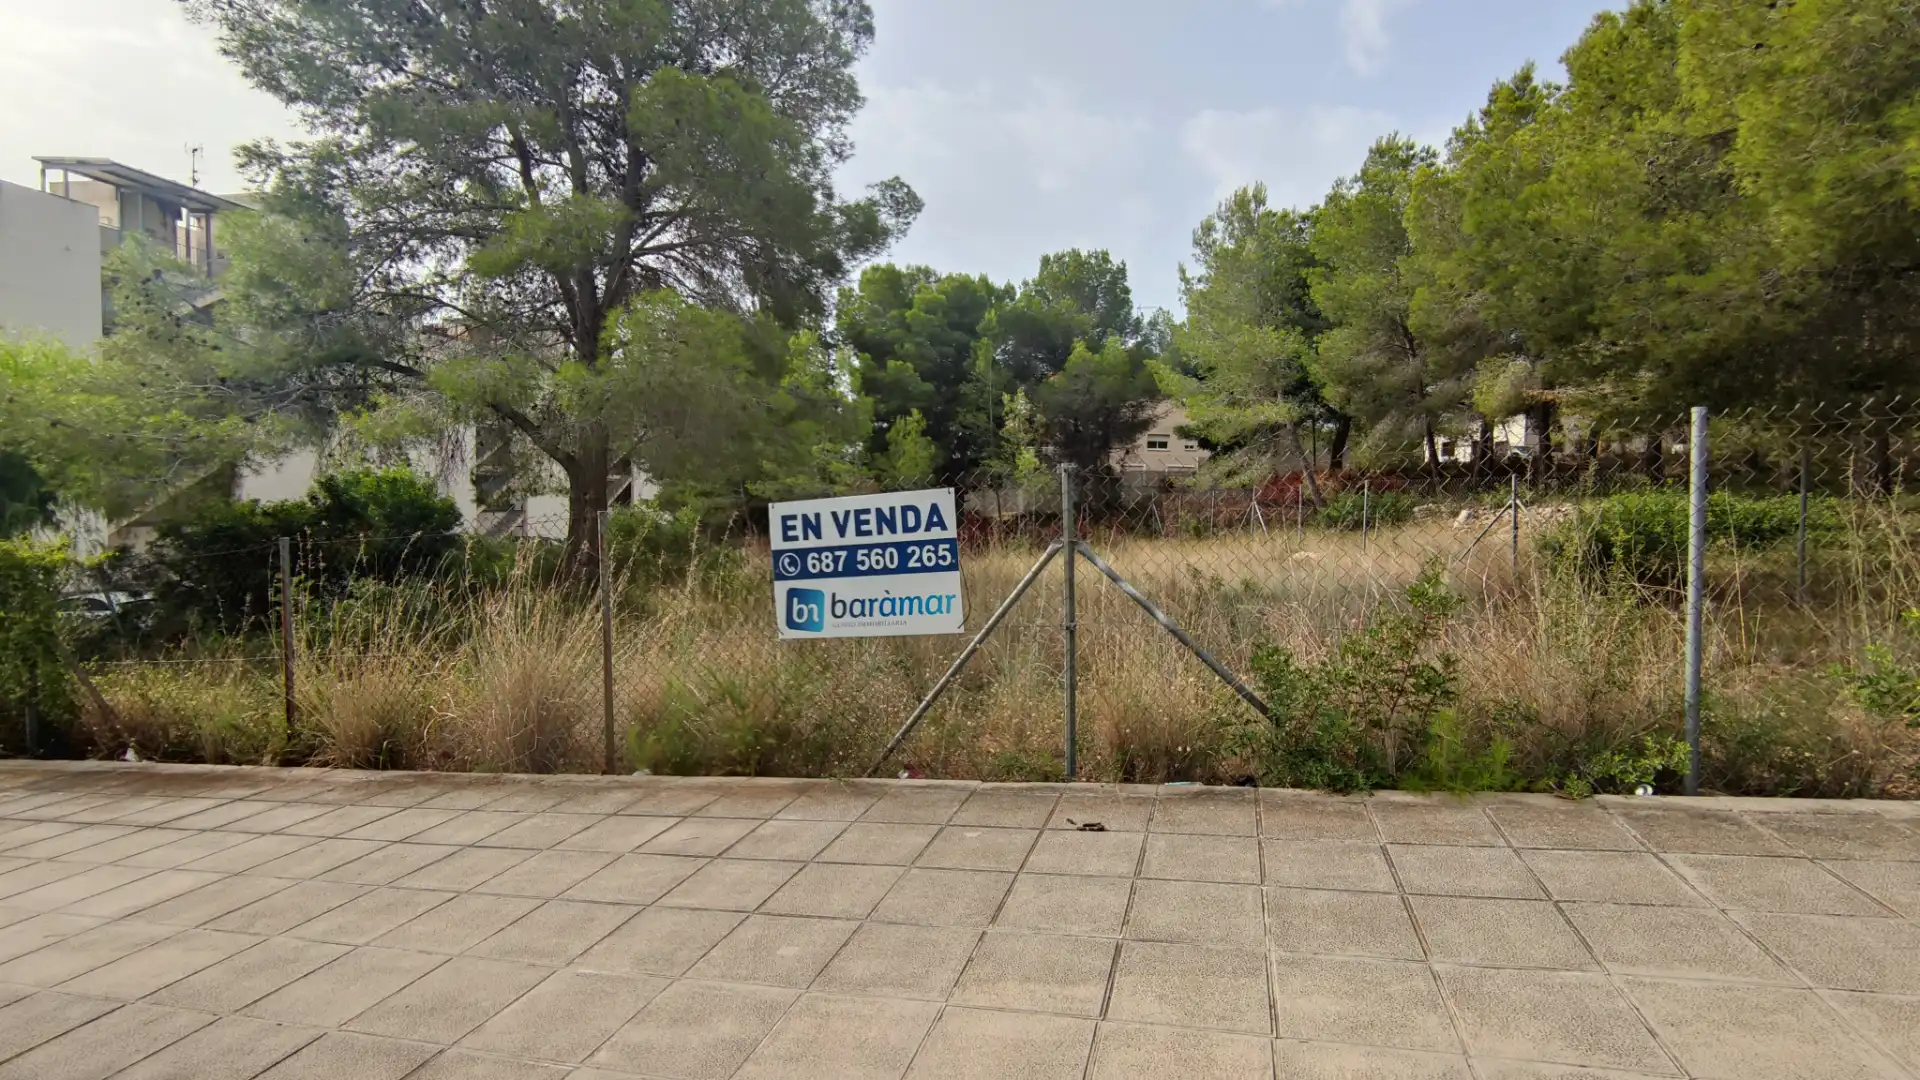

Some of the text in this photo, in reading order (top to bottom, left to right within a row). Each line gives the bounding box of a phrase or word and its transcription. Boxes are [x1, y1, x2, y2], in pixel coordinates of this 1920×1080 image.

[781, 503, 949, 543] EN VENDA
[806, 544, 952, 574] 687 560 265
[831, 590, 956, 619] baràmar
